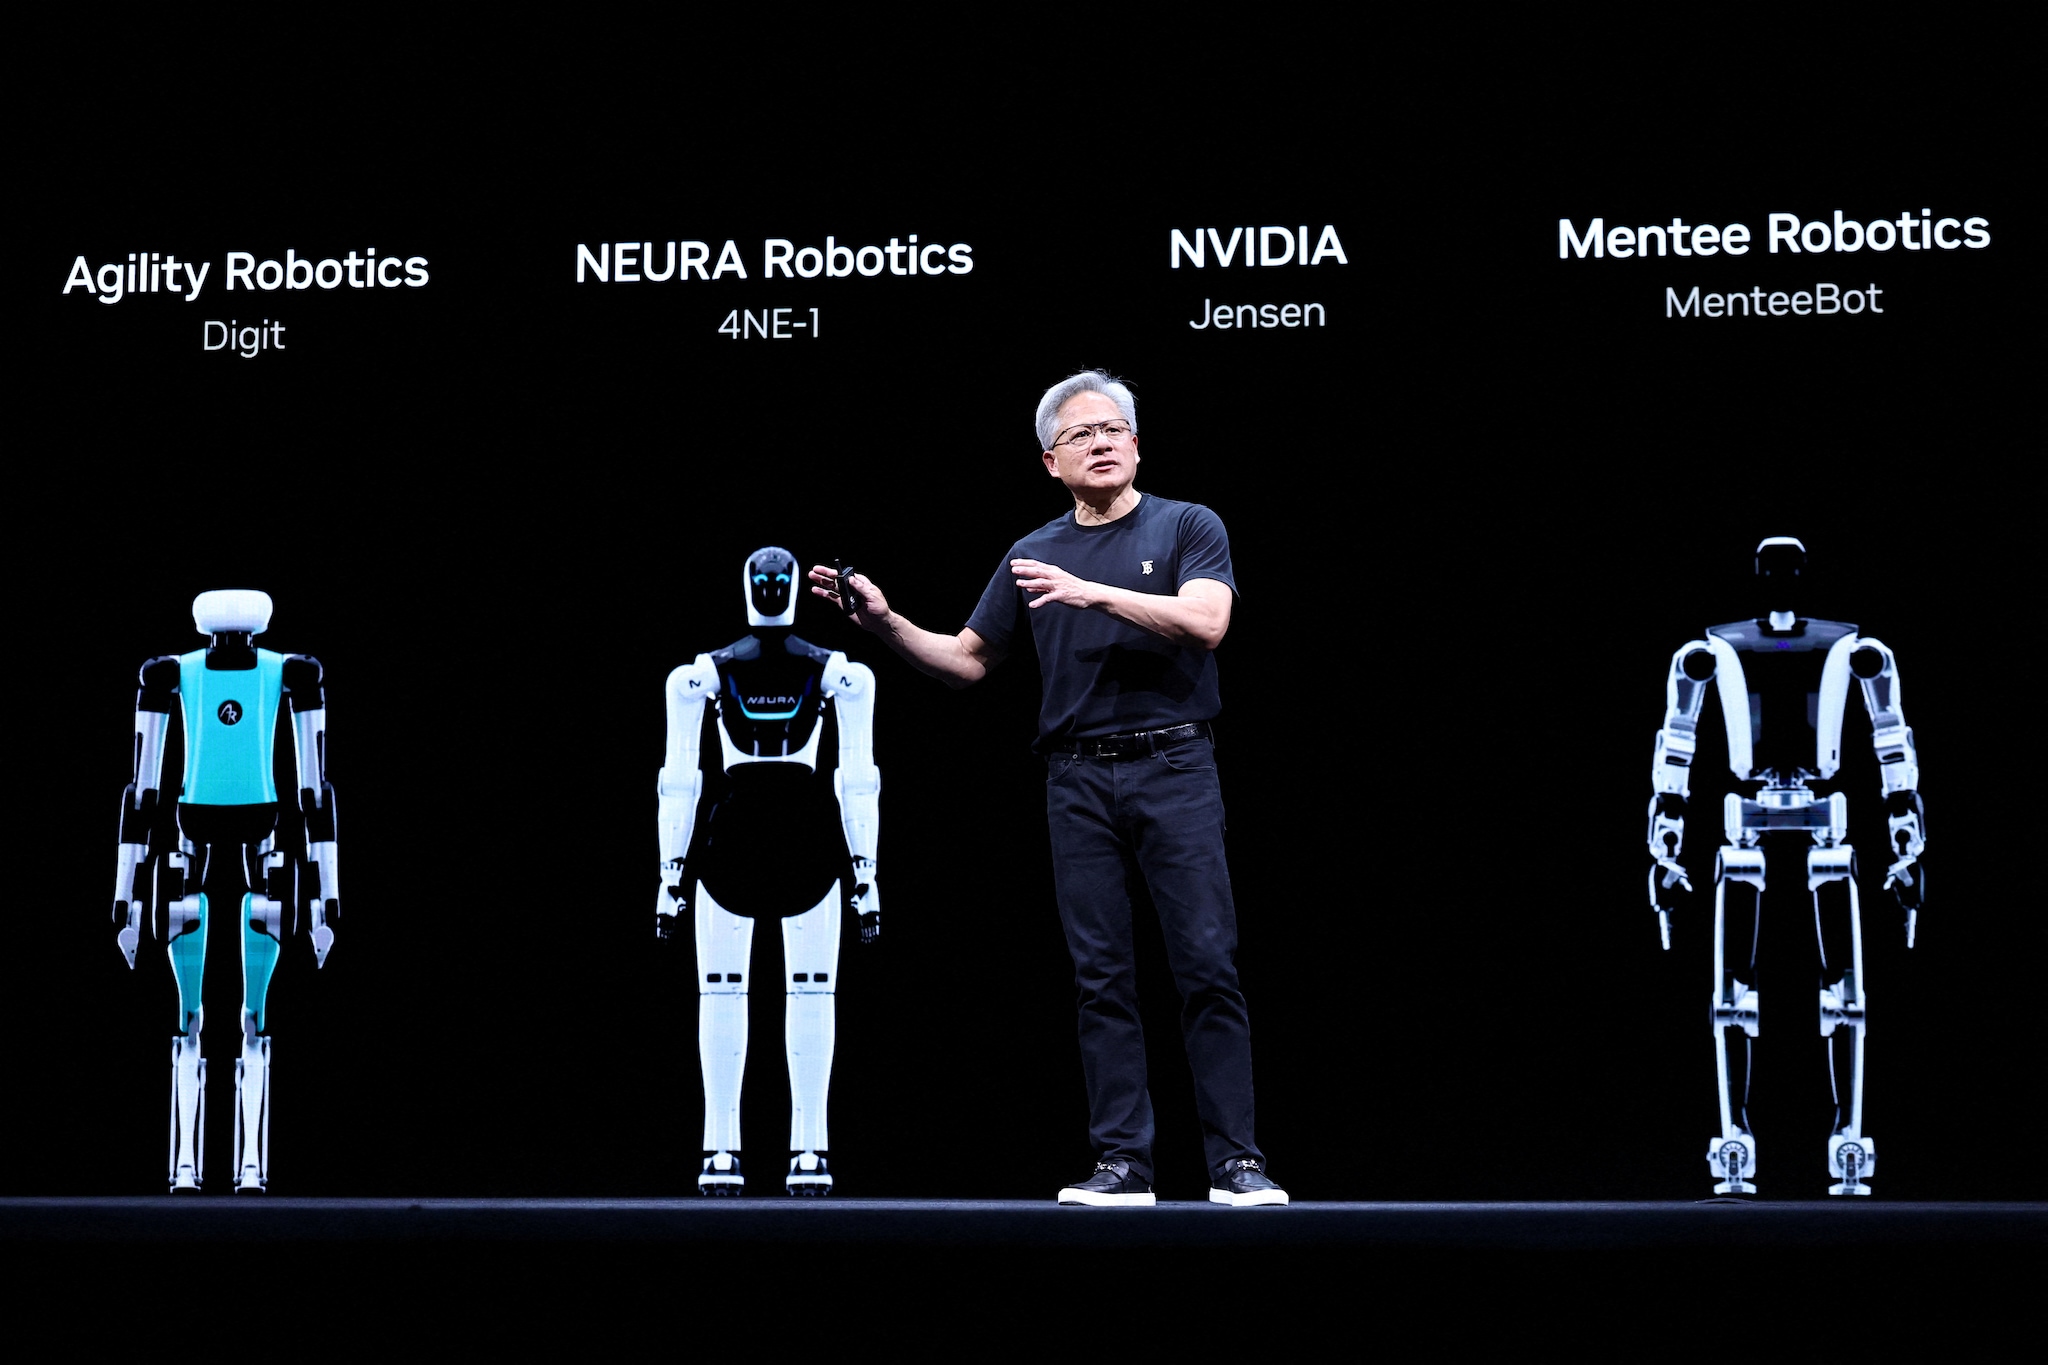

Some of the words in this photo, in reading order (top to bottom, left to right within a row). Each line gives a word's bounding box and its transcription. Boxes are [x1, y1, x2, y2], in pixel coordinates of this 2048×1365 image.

[1170, 224, 1349, 269] NVIDIA
[1558, 217, 1751, 260] Mentee
[1768, 207, 1991, 254] Robotics
[62, 252, 211, 305] Agility
[226, 247, 430, 291] Robotics
[576, 239, 748, 283] NEURA
[764, 233, 974, 279] Robotics
[1189, 298, 1326, 330] Jensen
[1666, 282, 1884, 319] MenteeBot
[203, 318, 286, 359] Digit
[717, 307, 819, 340] 4NE-1
[747, 695, 796, 705] NEURA
